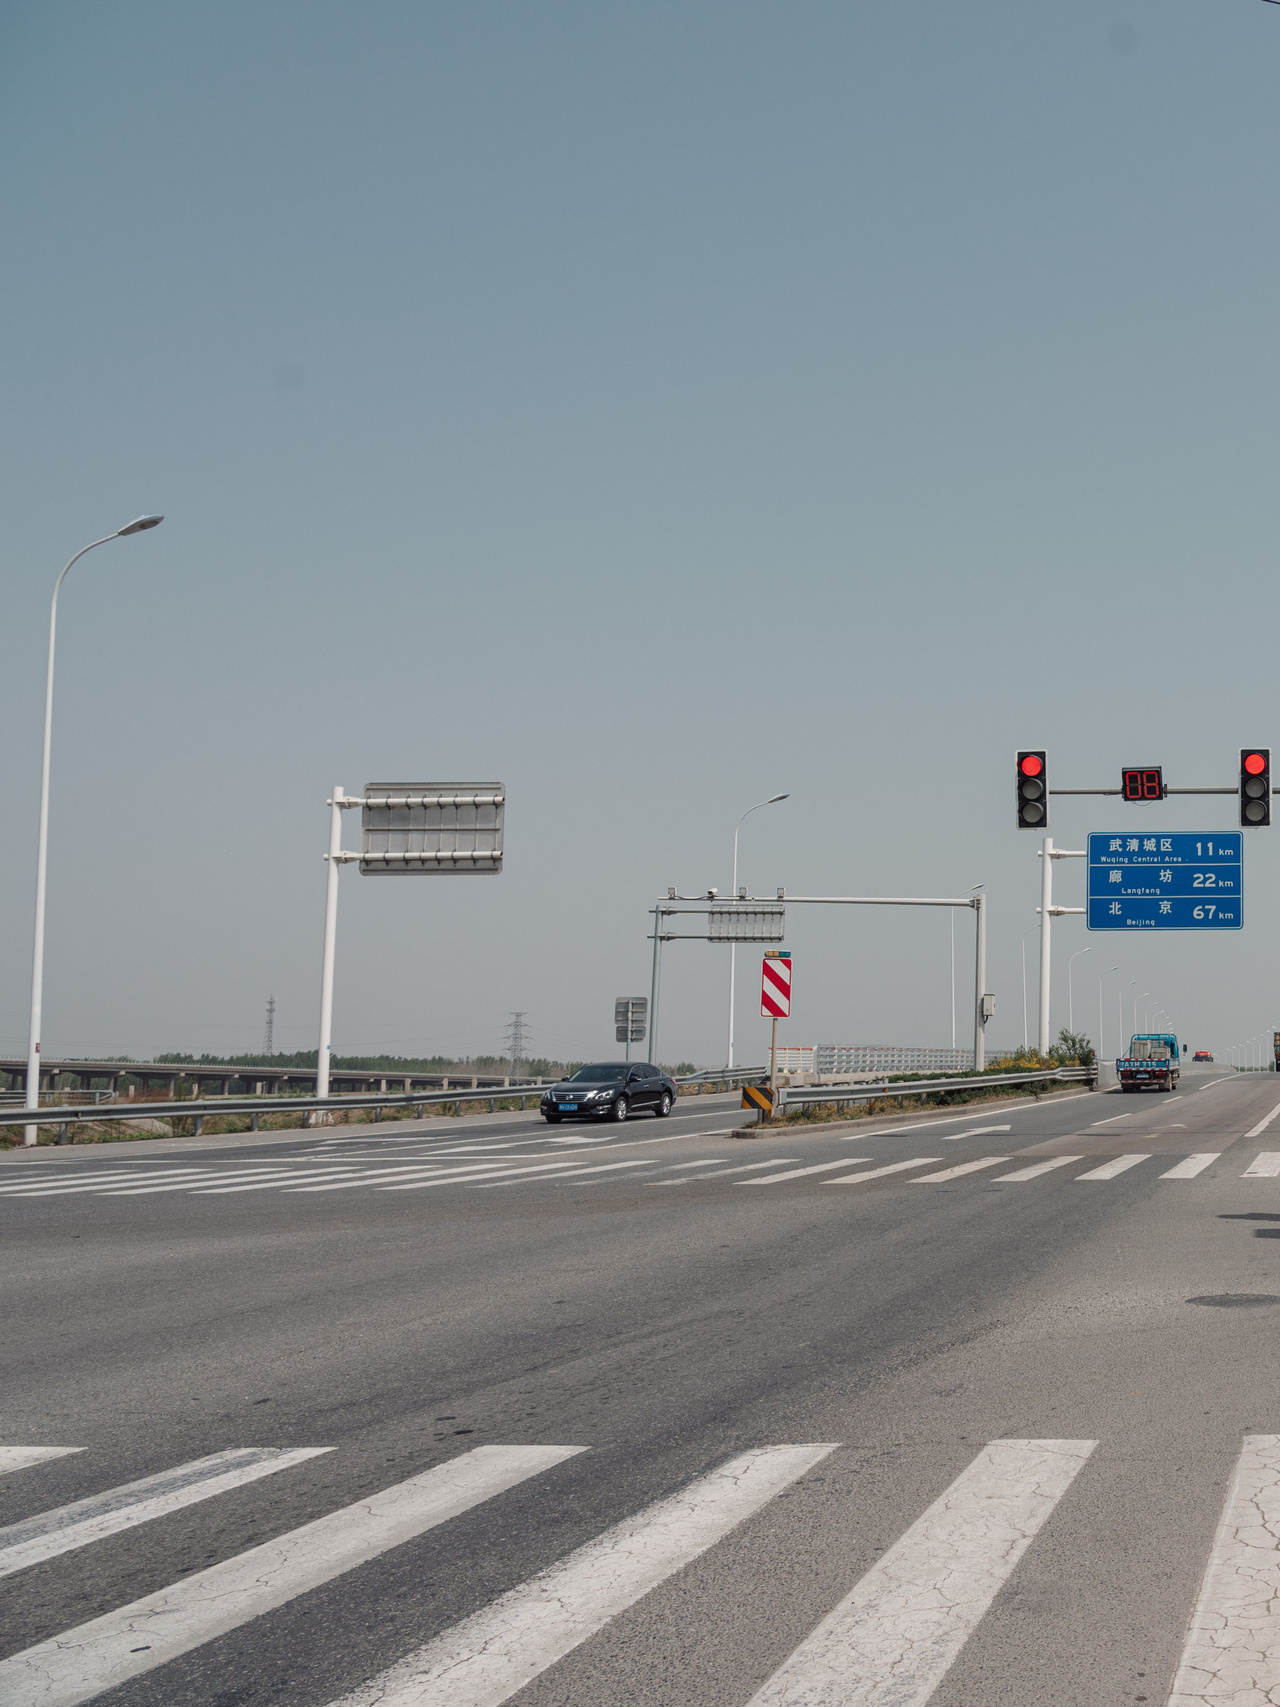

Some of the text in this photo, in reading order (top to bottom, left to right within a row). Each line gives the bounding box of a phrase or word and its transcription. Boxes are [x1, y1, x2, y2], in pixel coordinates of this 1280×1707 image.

[1126, 771, 1159, 798] 08
[1109, 838, 1173, 852] 武清城区
[1196, 842, 1234, 856] 11 km
[1100, 856, 1128, 864] Wuqing
[1192, 873, 1234, 888] 22 km
[1192, 905, 1234, 920] 67 km
